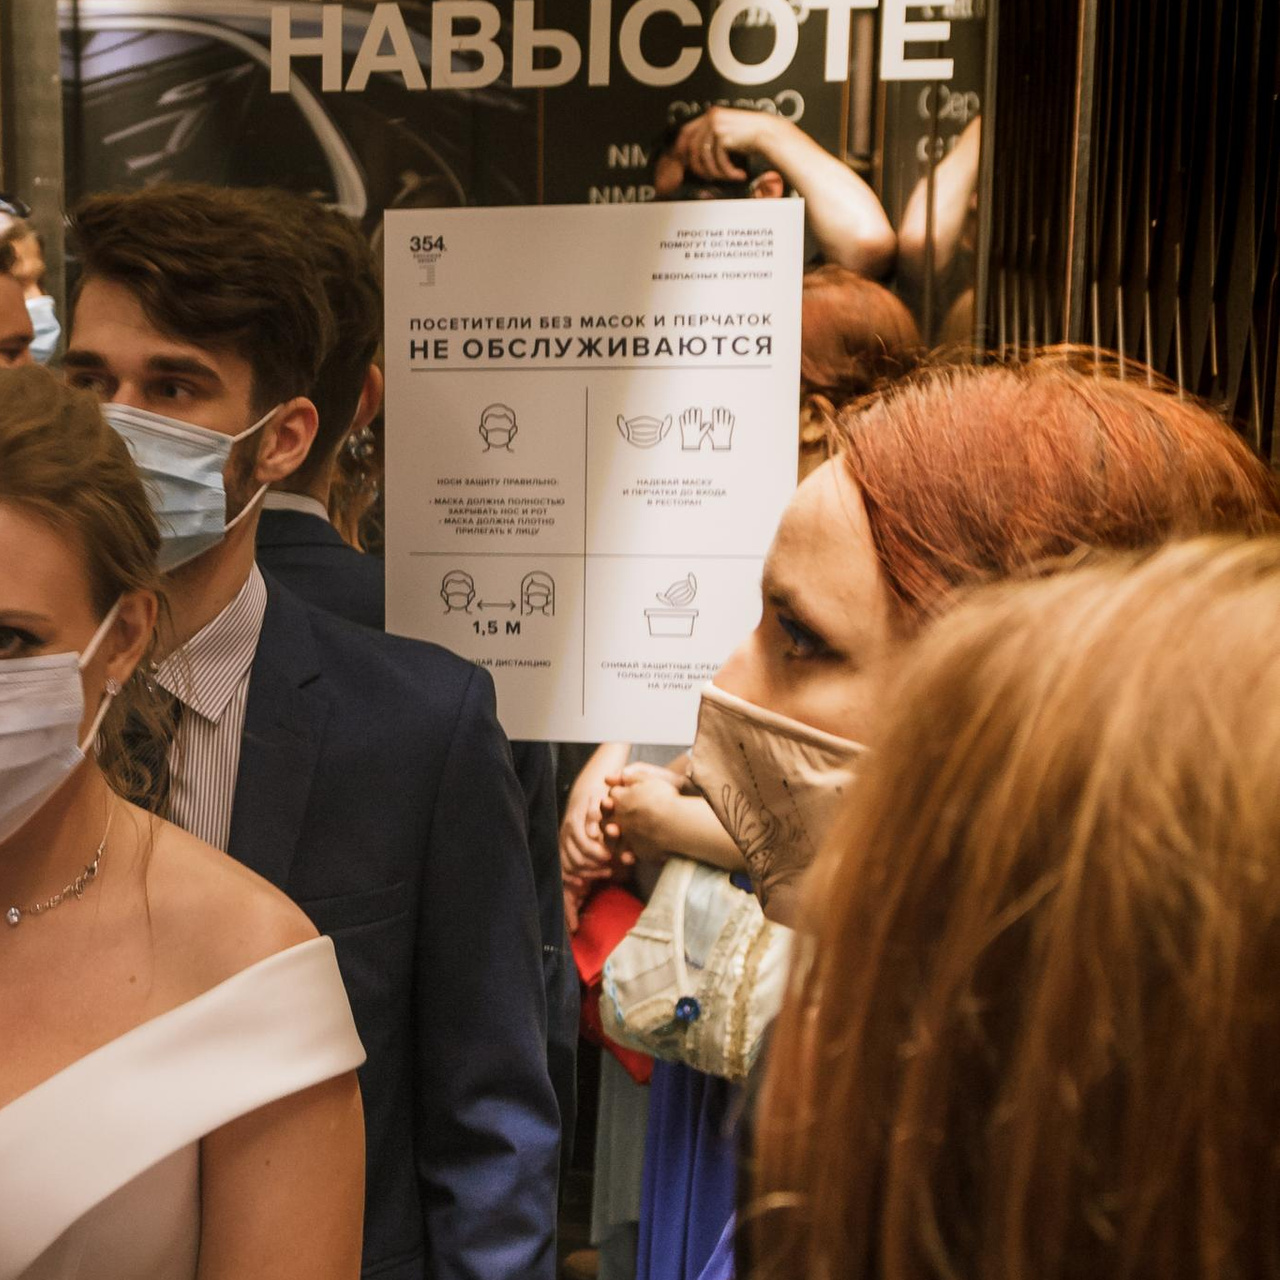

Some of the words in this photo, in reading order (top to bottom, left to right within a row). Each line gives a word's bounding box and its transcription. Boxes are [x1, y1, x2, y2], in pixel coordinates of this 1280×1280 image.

[659, 240, 707, 250] ПОМОГУТ
[409, 317, 532, 331] ПОСЕТИТЕЛИ
[539, 316, 573, 329] БЕЗ
[580, 314, 646, 329] МАСОК
[654, 314, 665, 327] И
[674, 313, 772, 327] ПЕРЧАТОК
[409, 339, 449, 360] НЕ
[463, 336, 773, 359] ОБСЛУЖИВАЮТСЯ
[434, 497, 464, 506] МАСКА
[467, 497, 505, 506] ДОЛЖНА
[472, 620, 498, 637] 1,5
